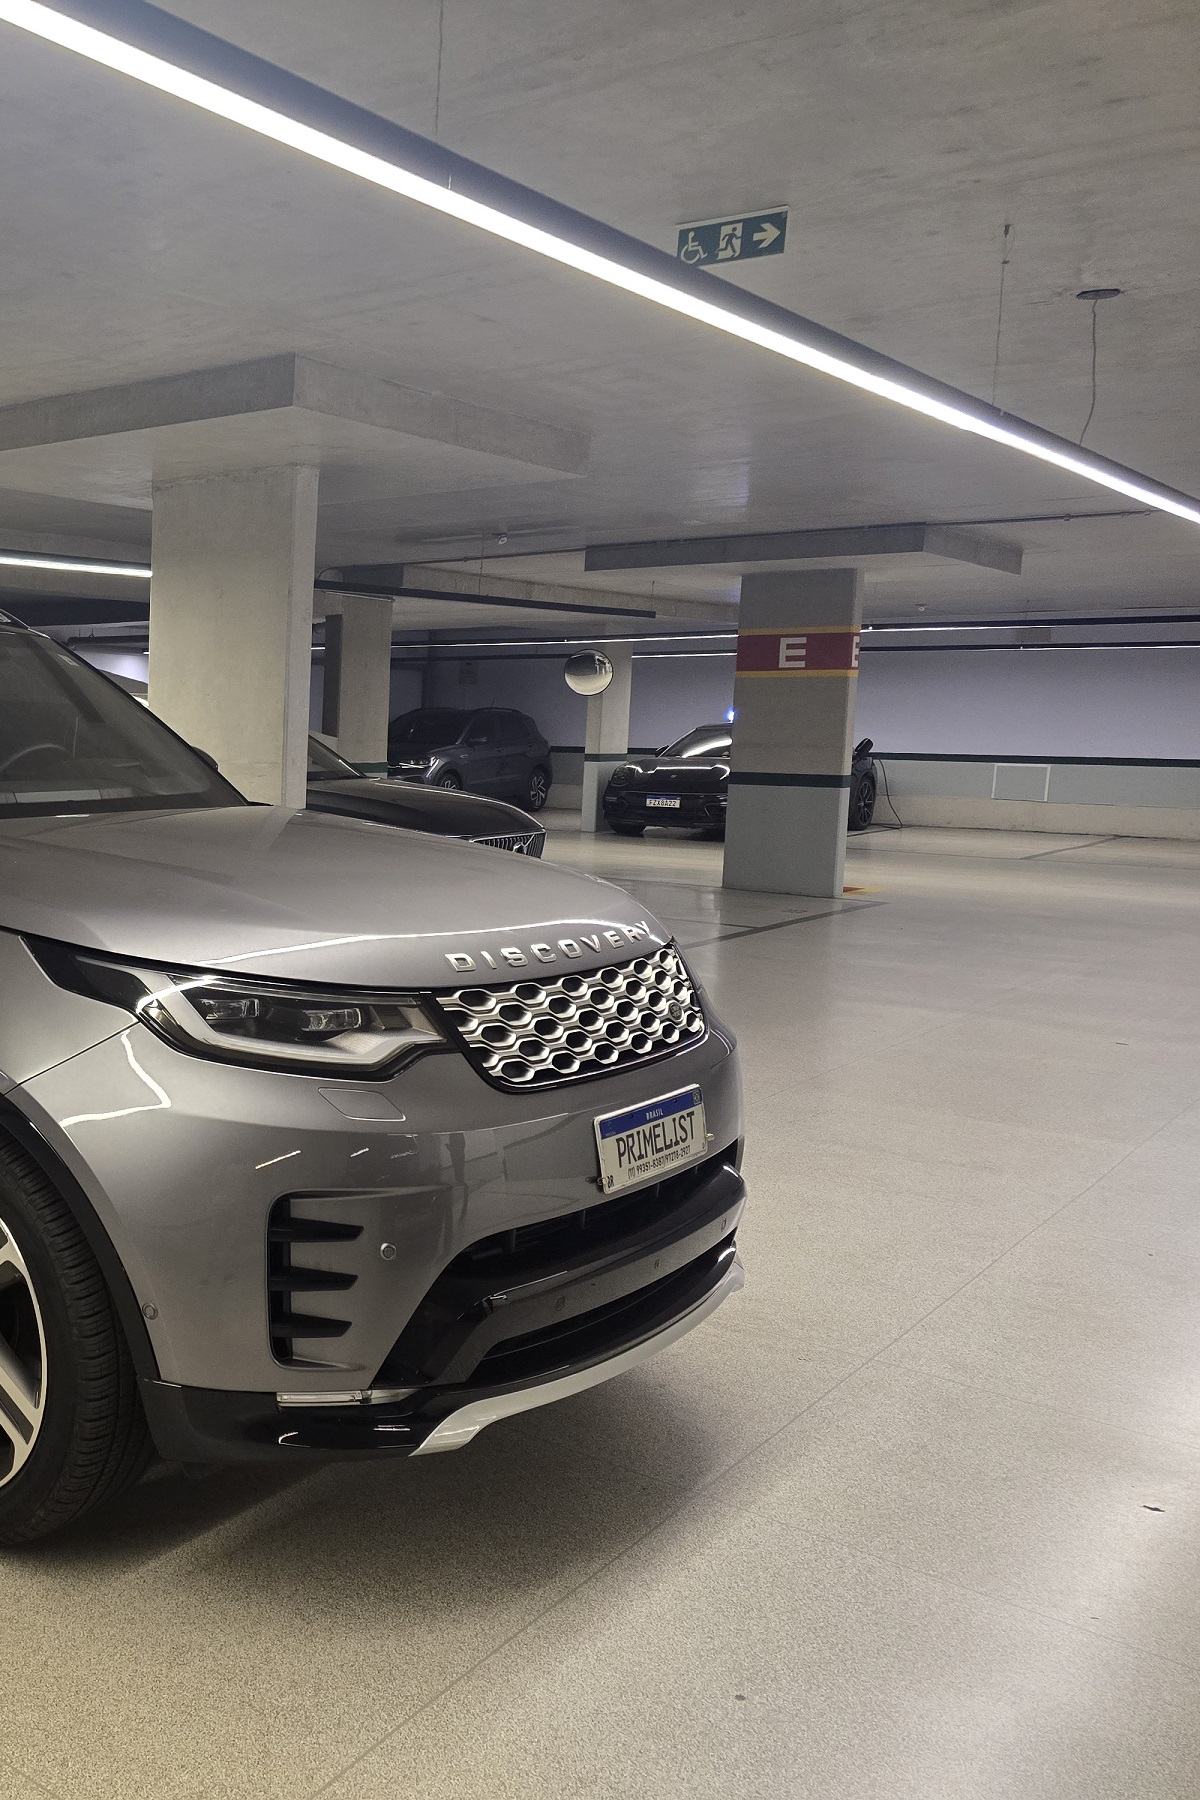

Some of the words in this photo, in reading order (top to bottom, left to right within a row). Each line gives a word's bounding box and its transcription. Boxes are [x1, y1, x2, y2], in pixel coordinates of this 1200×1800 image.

[779, 636, 807, 668] E
[445, 920, 651, 972] DISCOVERY
[645, 1108, 664, 1120] BRASIL
[615, 1111, 695, 1168] PRIMELIST
